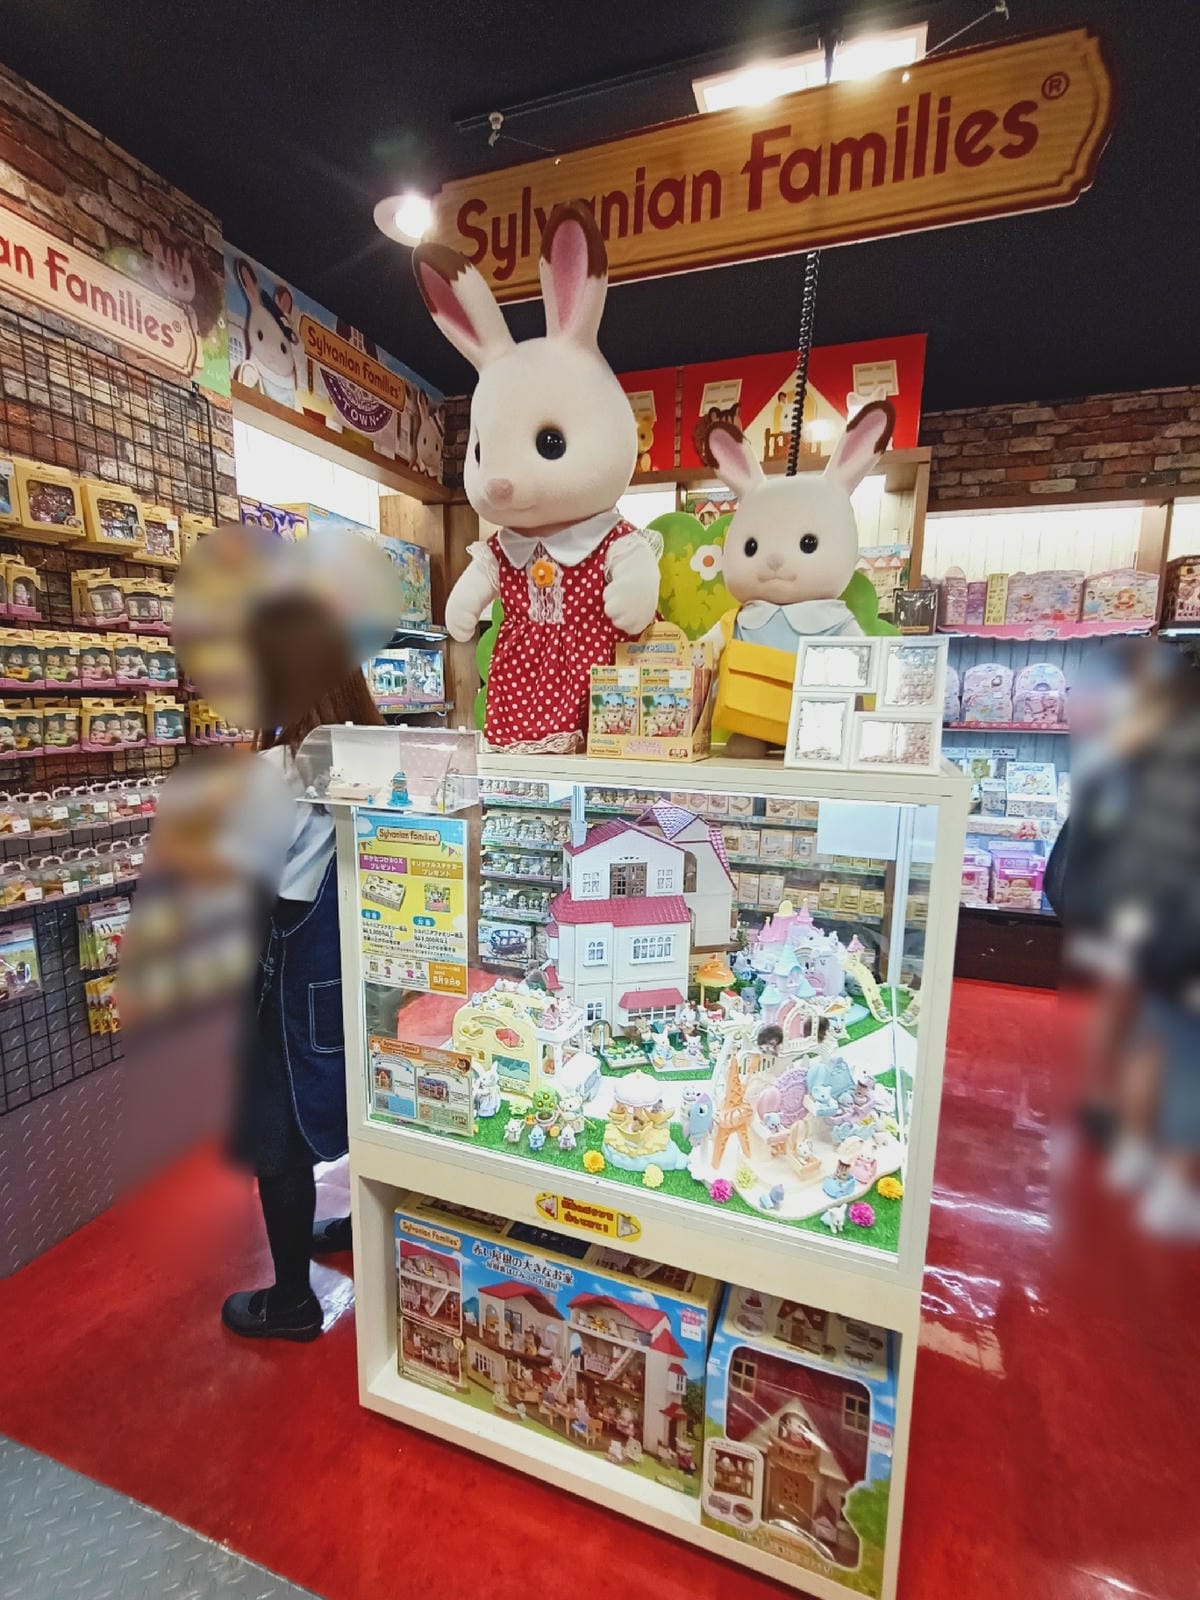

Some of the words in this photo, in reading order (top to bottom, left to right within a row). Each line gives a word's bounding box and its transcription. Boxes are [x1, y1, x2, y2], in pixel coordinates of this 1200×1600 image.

[457, 167, 722, 281] Sylvnian
[308, 326, 361, 372] Sylvanian
[342, 397, 377, 426] TOWN
